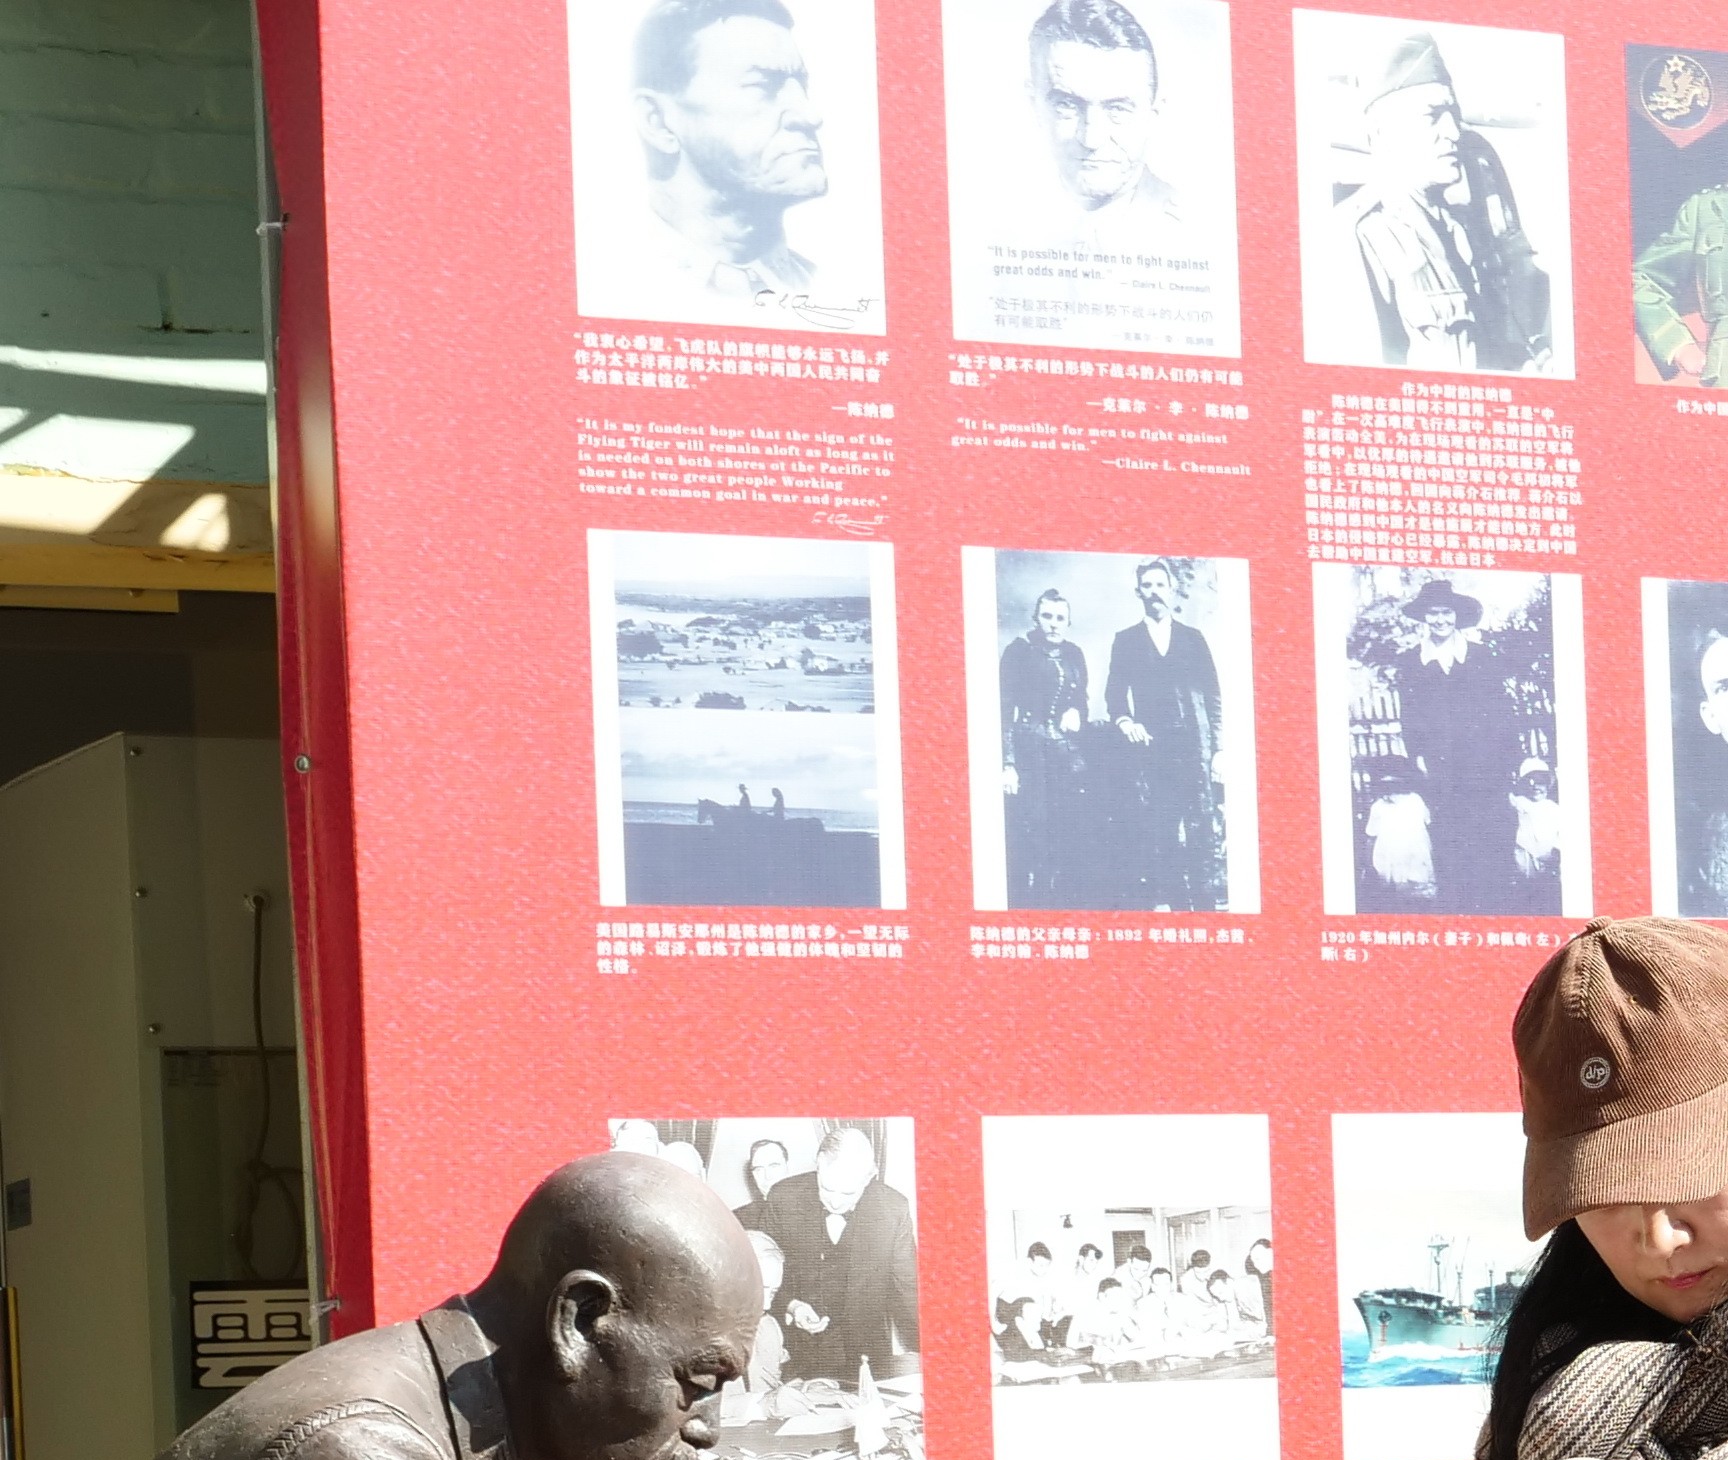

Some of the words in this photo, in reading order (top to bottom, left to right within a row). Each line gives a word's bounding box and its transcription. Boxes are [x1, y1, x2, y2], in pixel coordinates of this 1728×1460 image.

[988, 246, 1002, 258] “It
[1007, 248, 1017, 258] is
[1021, 249, 1069, 263] possible
[1074, 251, 1089, 262] for
[1094, 254, 1117, 263] men
[1121, 255, 1132, 264] to
[1137, 255, 1162, 268] fight
[1167, 258, 1209, 271] against
[577, 419, 597, 431] “It
[604, 420, 617, 431] is
[623, 422, 642, 434] my
[649, 422, 704, 436] fondest
[710, 426, 744, 439] hope
[750, 427, 780, 440] that
[786, 429, 809, 442] the
[815, 431, 845, 446] sign
[850, 433, 865, 445] of
[870, 435, 892, 446] the
[957, 416, 977, 430] “It
[982, 420, 995, 431] is
[1000, 421, 1057, 435] possible
[1062, 423, 1084, 436] for
[1088, 427, 1117, 438] men
[1121, 427, 1136, 439] to
[1140, 427, 1173, 442] fight
[1178, 431, 1227, 445] against
[577, 433, 625, 450] Flying
[630, 436, 670, 450] Tiger
[676, 439, 704, 451] will
[709, 441, 760, 454] remain
[765, 443, 800, 456] aloft
[806, 447, 822, 458] as
[826, 446, 857, 461] long
[862, 450, 878, 460] as
[884, 450, 895, 461] it
[578, 450, 591, 462] is
[597, 451, 649, 465] needed
[655, 455, 673, 466] on
[678, 455, 711, 468] both
[717, 457, 765, 471] shores
[792, 460, 814, 473] the
[820, 462, 870, 476] Pacific
[876, 465, 890, 477] to
[578, 466, 615, 478] show
[622, 468, 645, 480] the
[651, 471, 678, 482] two
[684, 473, 723, 485] great
[728, 475, 776, 488] people
[782, 476, 843, 492] Working
[580, 482, 632, 495] toward
[637, 486, 645, 496] a
[651, 486, 711, 499] common
[716, 488, 746, 502] goal
[753, 490, 766, 502] in
[772, 493, 799, 504] war
[804, 494, 829, 506] and
[834, 495, 888, 508] peace.”
